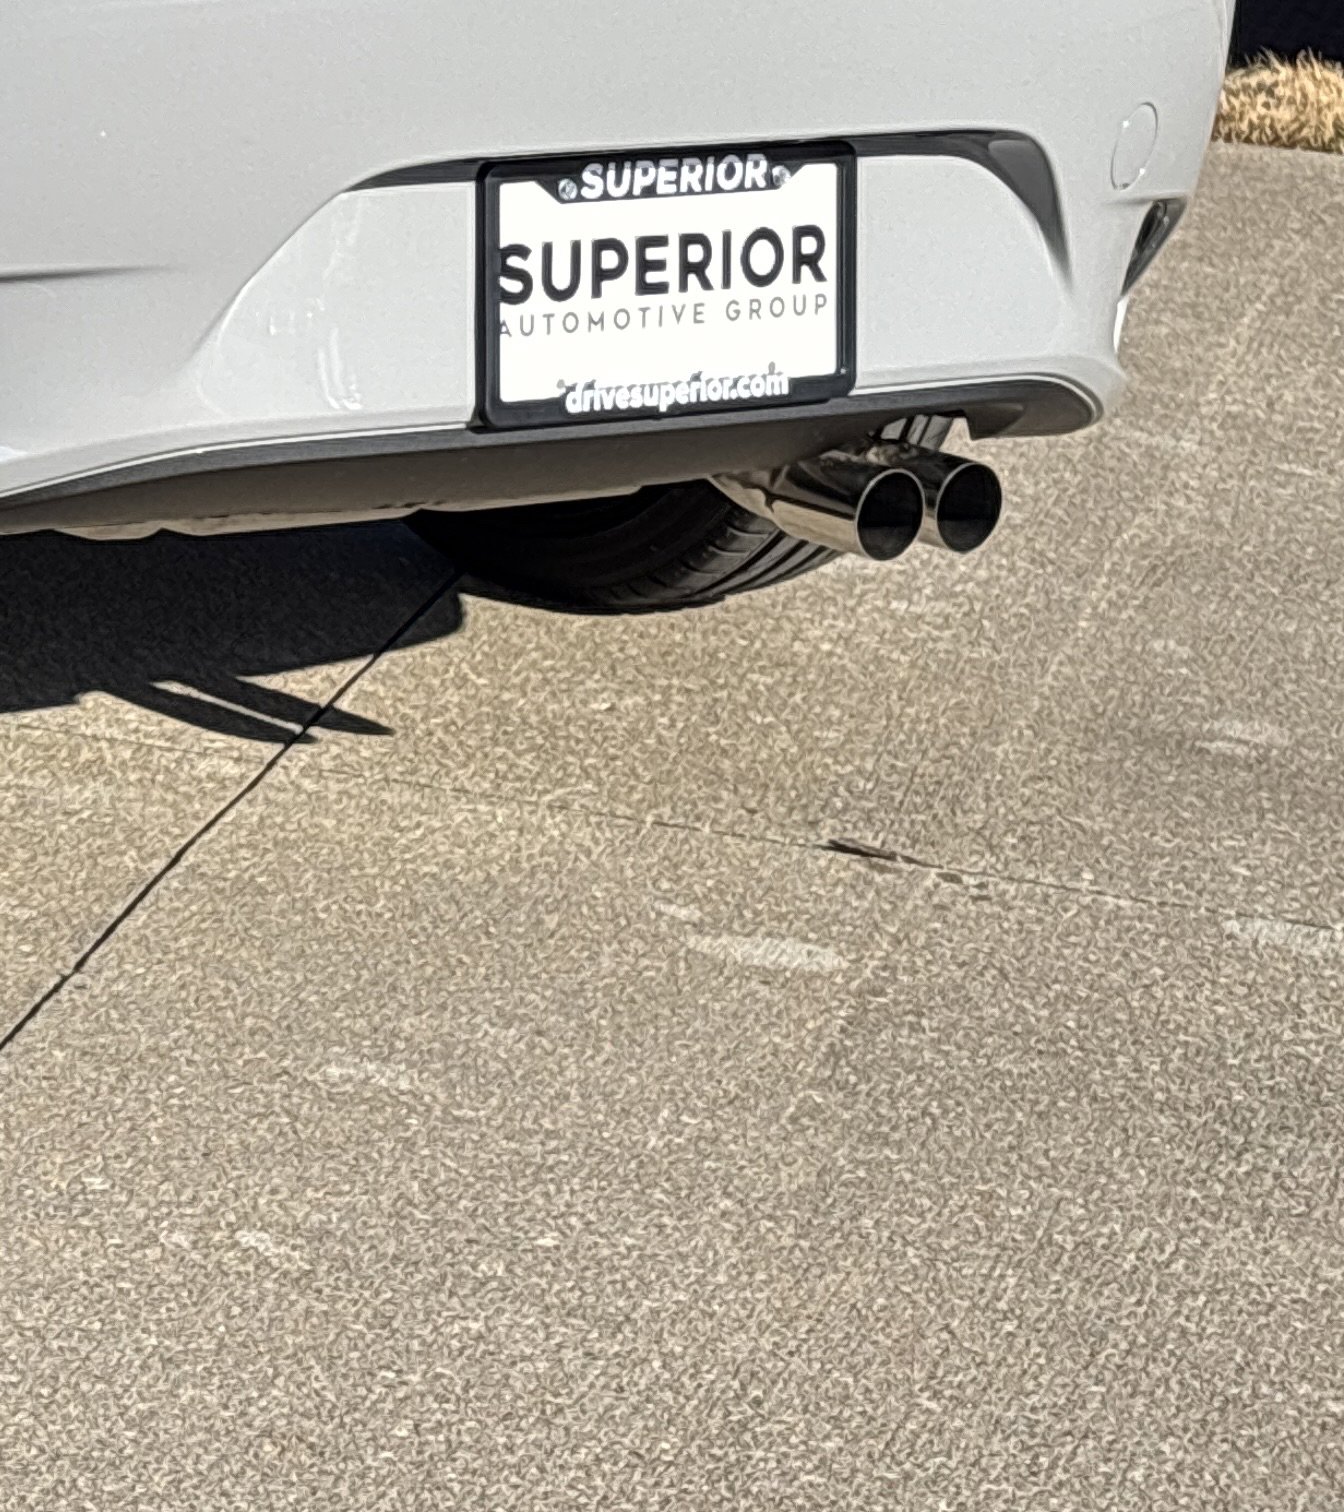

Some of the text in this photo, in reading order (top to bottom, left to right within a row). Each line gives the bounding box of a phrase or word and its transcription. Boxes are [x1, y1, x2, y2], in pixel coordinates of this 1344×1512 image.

[580, 154, 769, 200] SUPERIOR
[498, 224, 828, 306] SUPERIOR
[499, 293, 829, 338] AUTOMOTIVE GROUP
[564, 368, 790, 415] drivesuperior.com
